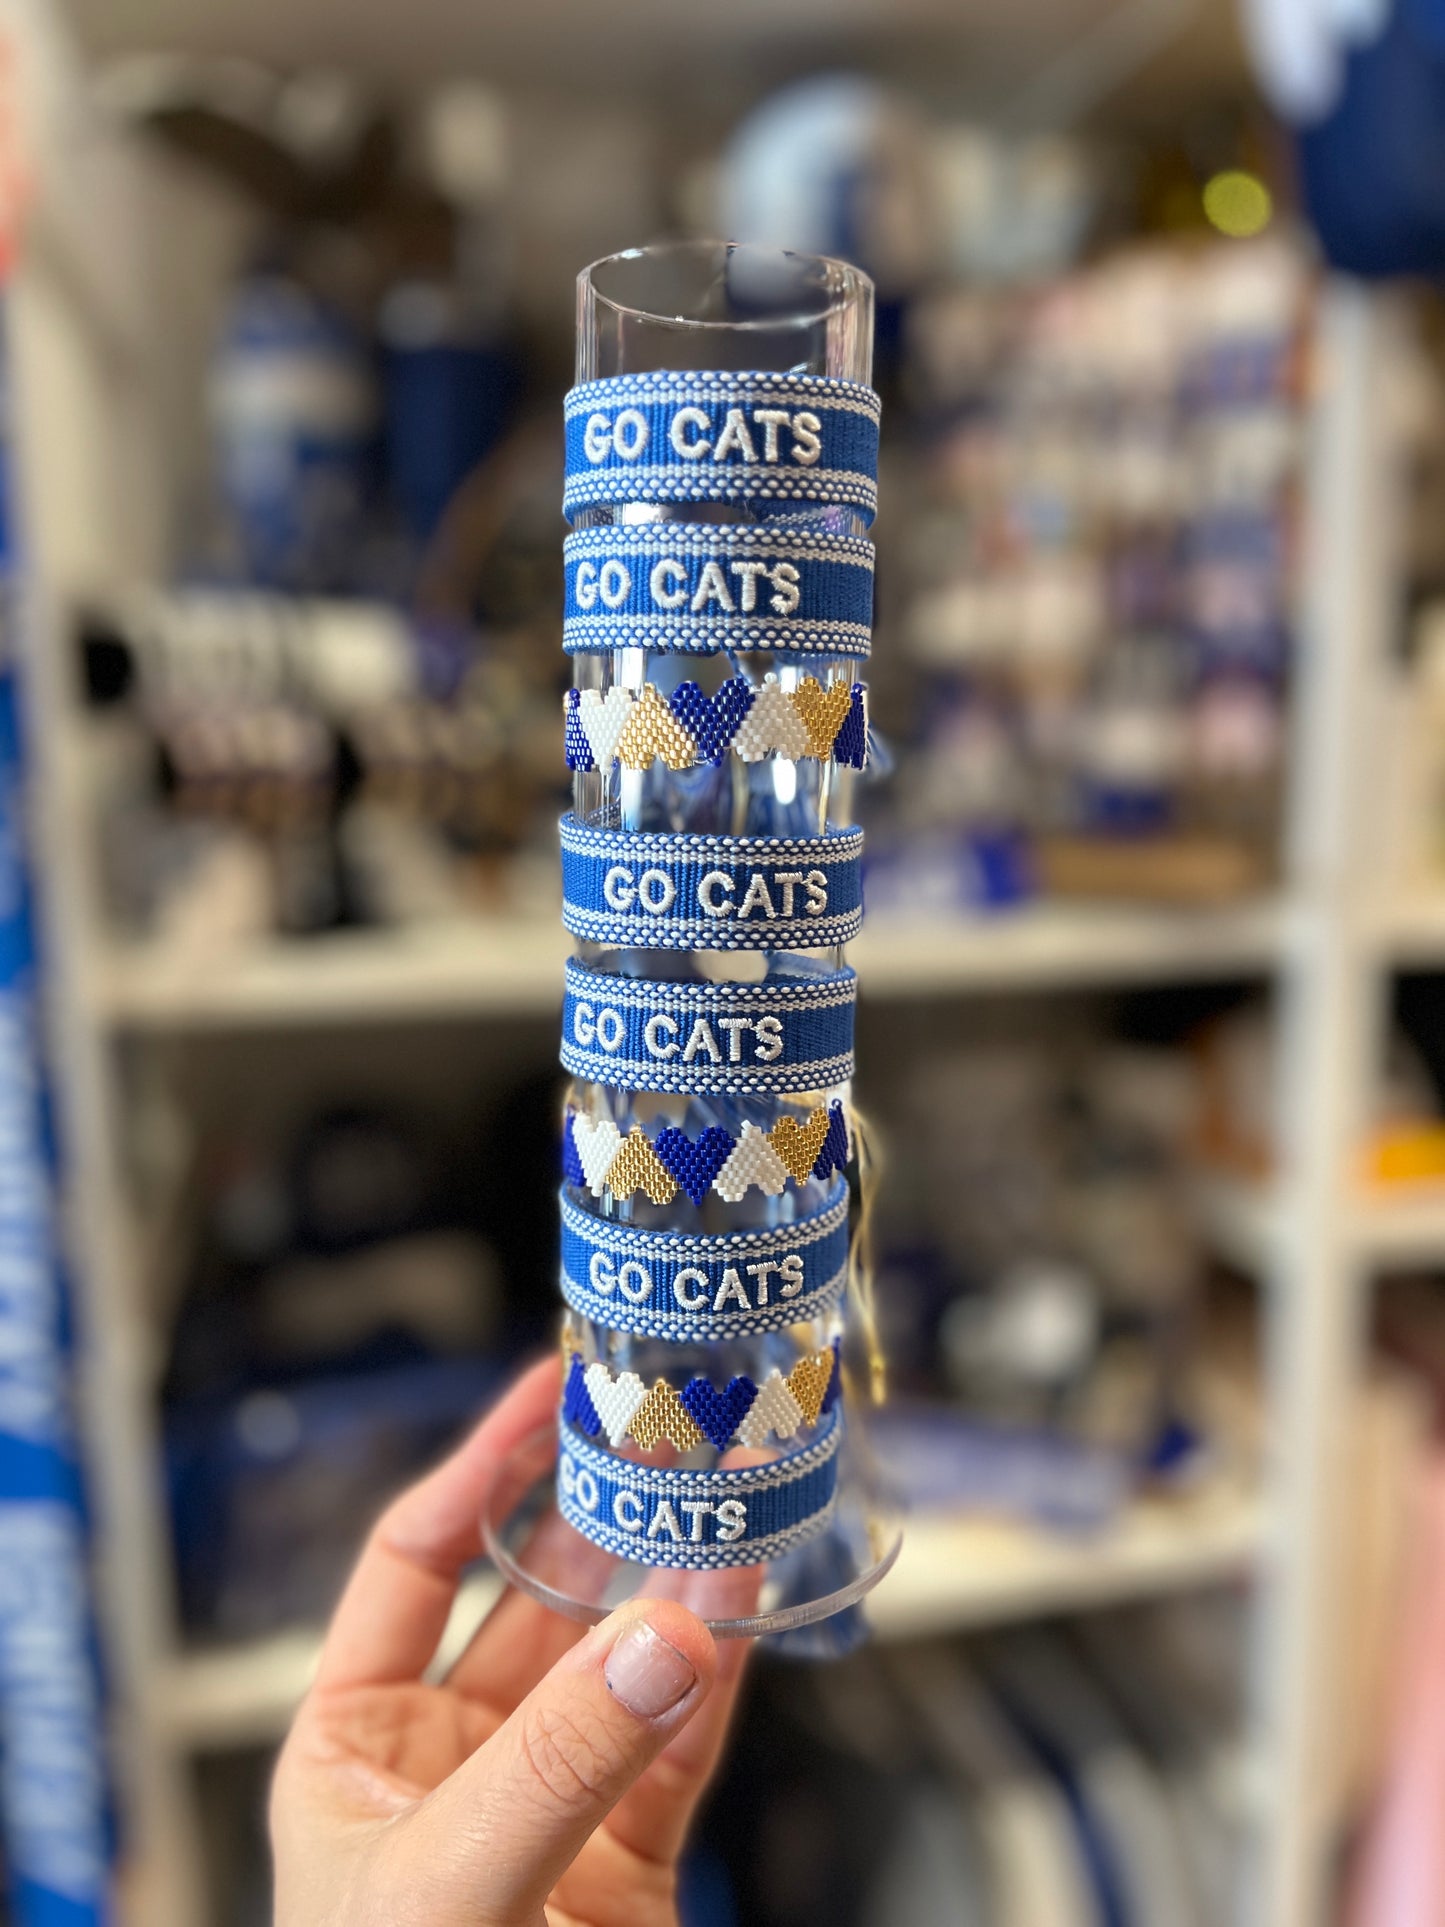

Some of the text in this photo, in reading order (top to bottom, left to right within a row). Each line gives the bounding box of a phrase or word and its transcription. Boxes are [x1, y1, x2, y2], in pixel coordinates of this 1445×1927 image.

[584, 407, 821, 465] GO CATS
[576, 559, 799, 615] GO CATS
[604, 866, 827, 918] GO CATS
[574, 1002, 783, 1062] GO CATS
[589, 1251, 804, 1311] GO CATS
[560, 1453, 747, 1541] GO CATS
